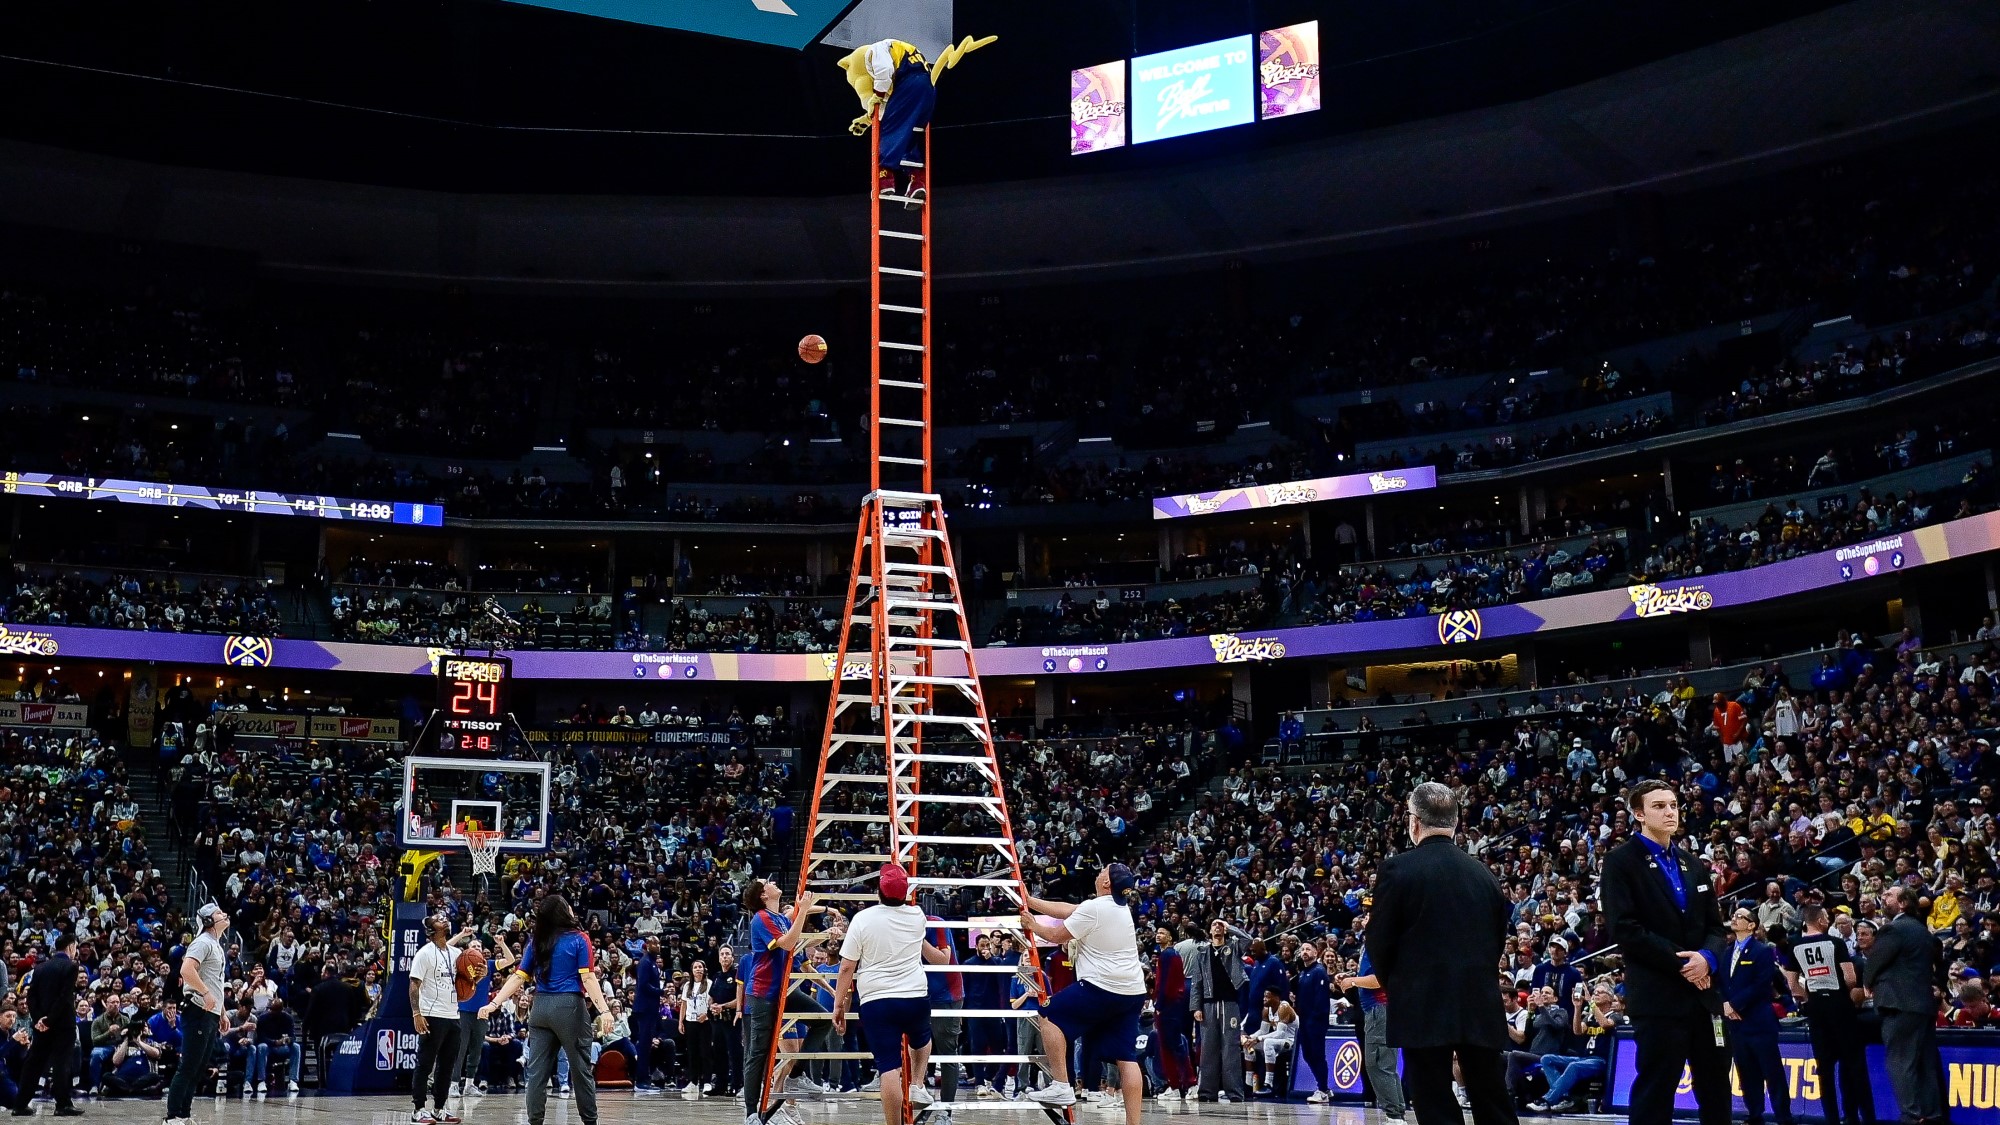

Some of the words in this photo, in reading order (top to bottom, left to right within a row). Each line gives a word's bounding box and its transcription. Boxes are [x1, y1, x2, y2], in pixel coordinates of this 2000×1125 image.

[1139, 55, 1220, 83] WELCOME
[1223, 50, 1247, 66] TO
[1156, 74, 1213, 130] Ball
[1180, 99, 1230, 119] Arena
[447, 466, 463, 474] 363
[4, 483, 17, 493] 32
[167, 484, 174, 493] 7
[167, 496, 178, 506] 12
[245, 490, 256, 500] 12
[319, 497, 326, 506] 0
[245, 502, 255, 512] 13
[319, 508, 325, 517] 0
[350, 503, 391, 519] 12:00
[1836, 536, 1903, 562] @TheSuperMascot
[1124, 590, 1142, 599] 252
[1647, 586, 1702, 614] Rocky
[1042, 646, 1109, 658] @TheSuperMascot
[1226, 636, 1275, 661] Rocky
[632, 653, 698, 665] @TheSuperMascot
[452, 682, 496, 715] 24
[0, 709, 17, 718] HE
[58, 711, 82, 721] BAR
[24, 706, 54, 722] Banquet
[313, 722, 337, 733] THE
[343, 720, 370, 736] Banquet
[372, 725, 396, 735] BAR
[460, 721, 502, 731] TISSOT
[461, 735, 489, 750] 2:18
[586, 730, 649, 743] FOUNDATION
[654, 732, 731, 744] EDDIESKIDS.ORG
[404, 930, 419, 943] GET
[404, 944, 418, 957] THE
[1804, 946, 1824, 965] 64
[395, 1050, 416, 1070] Pas
[1949, 1063, 2000, 1109] NU
